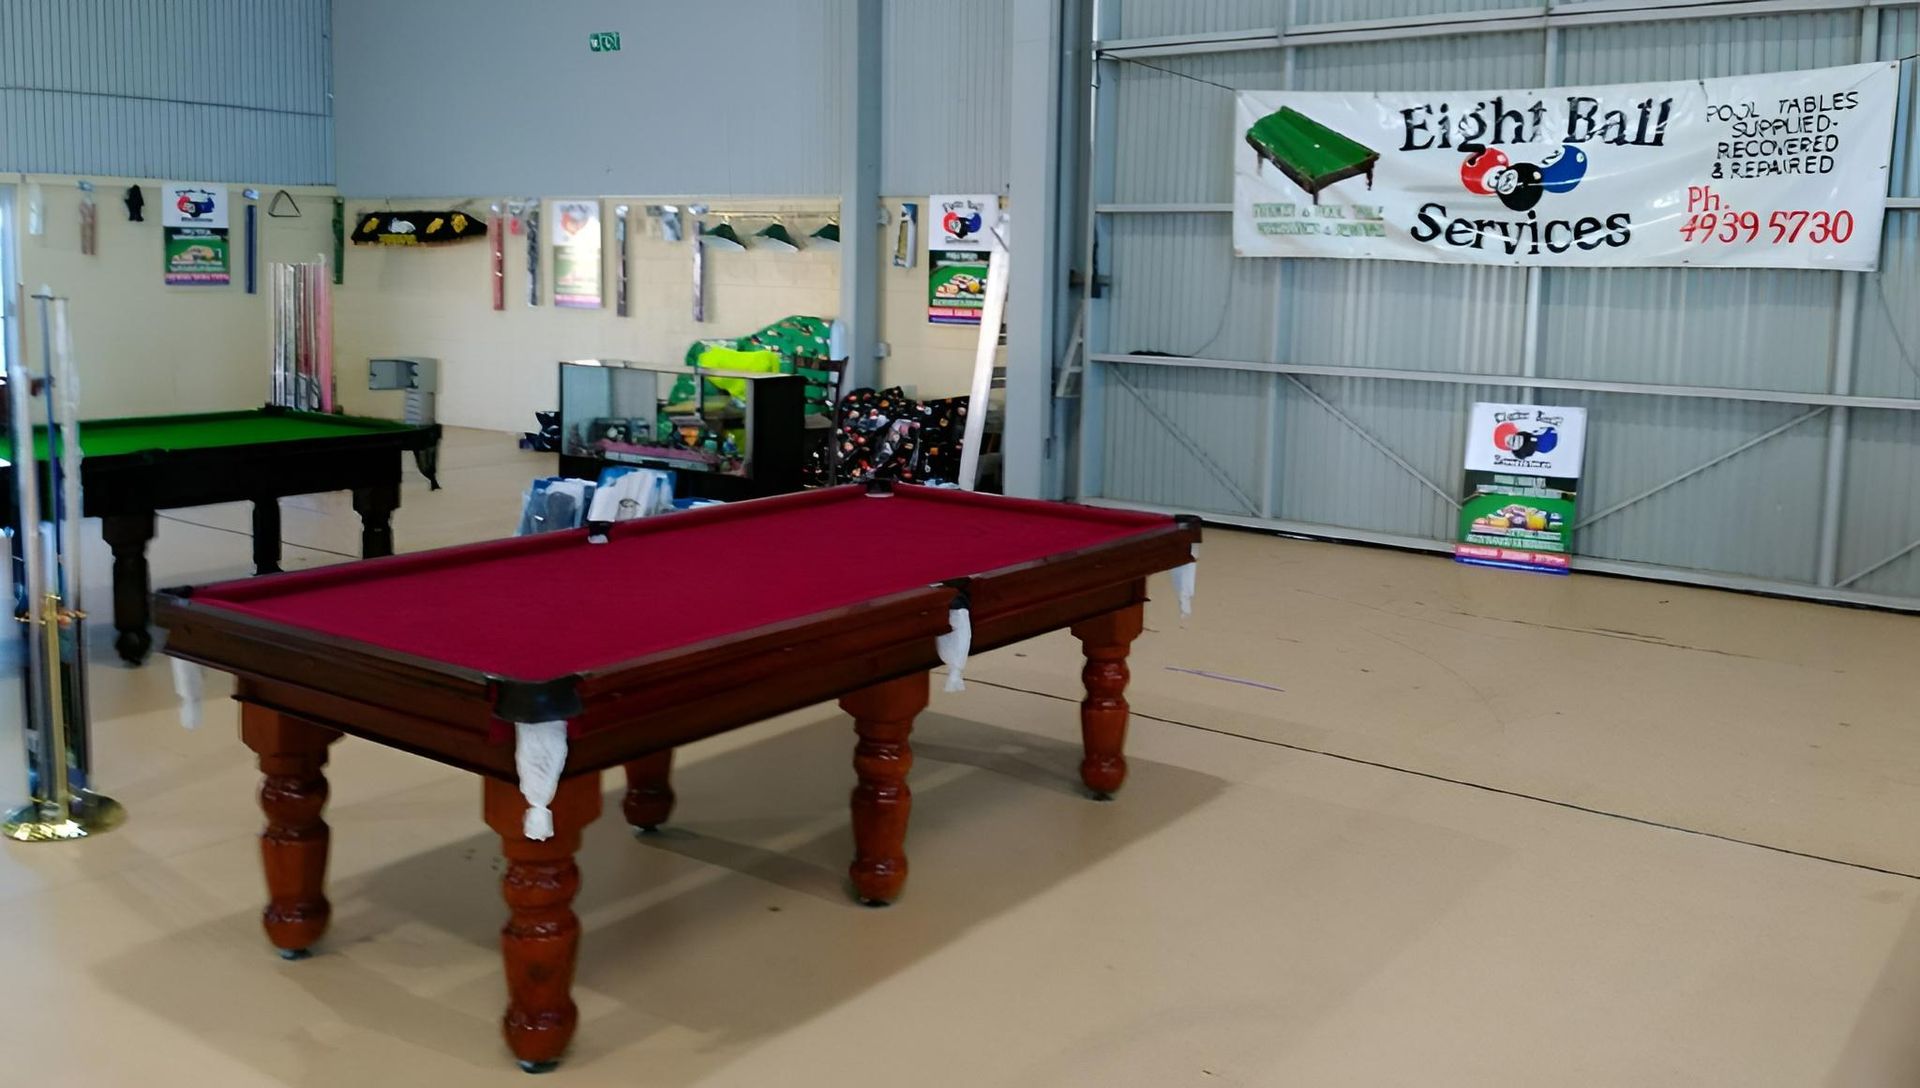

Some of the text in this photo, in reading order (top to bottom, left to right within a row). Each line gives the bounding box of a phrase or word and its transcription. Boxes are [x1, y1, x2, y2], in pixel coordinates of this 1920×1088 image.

[1706, 92, 1859, 122] POOL TABLES
[1398, 96, 1674, 165] Eight Ball
[1731, 155, 1835, 179] REPAIRED
[1687, 185, 1731, 212] Ph.
[1410, 203, 1632, 255] Services
[1679, 210, 1855, 244] 4939 5730
